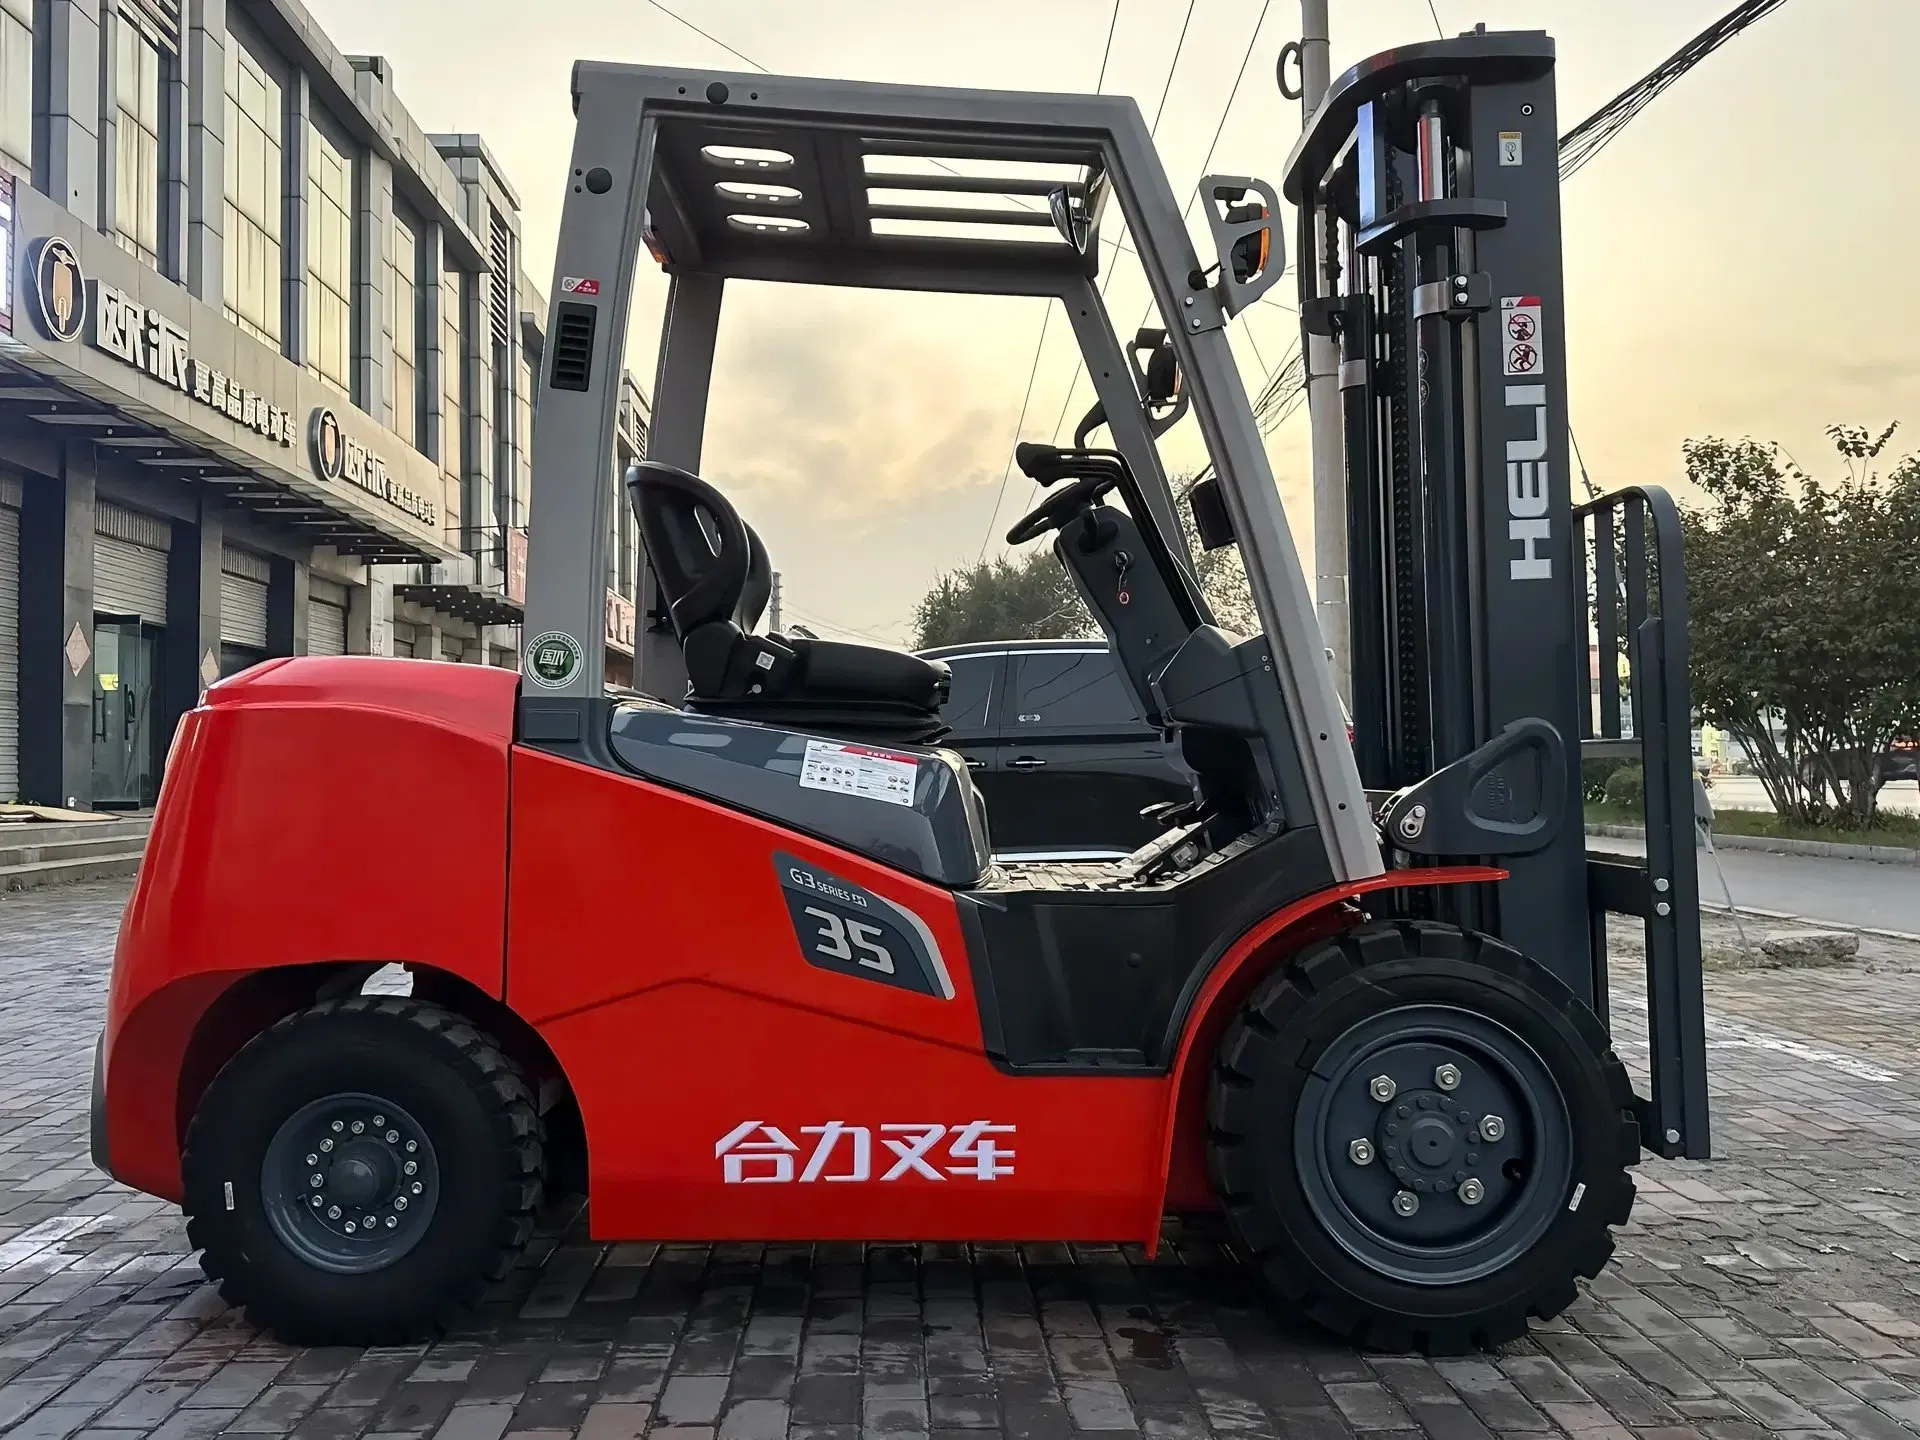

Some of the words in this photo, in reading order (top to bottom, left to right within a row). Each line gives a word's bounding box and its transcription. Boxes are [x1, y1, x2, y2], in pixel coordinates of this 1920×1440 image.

[97, 280, 189, 391] 欧派
[194, 359, 297, 448] 更高品质电动车
[344, 434, 388, 500] 欧派
[1505, 384, 1552, 580] HELI
[789, 867, 816, 889] G3
[816, 881, 851, 901] SERIES
[804, 906, 895, 974] 35
[715, 1120, 1017, 1183] 合力叉车
